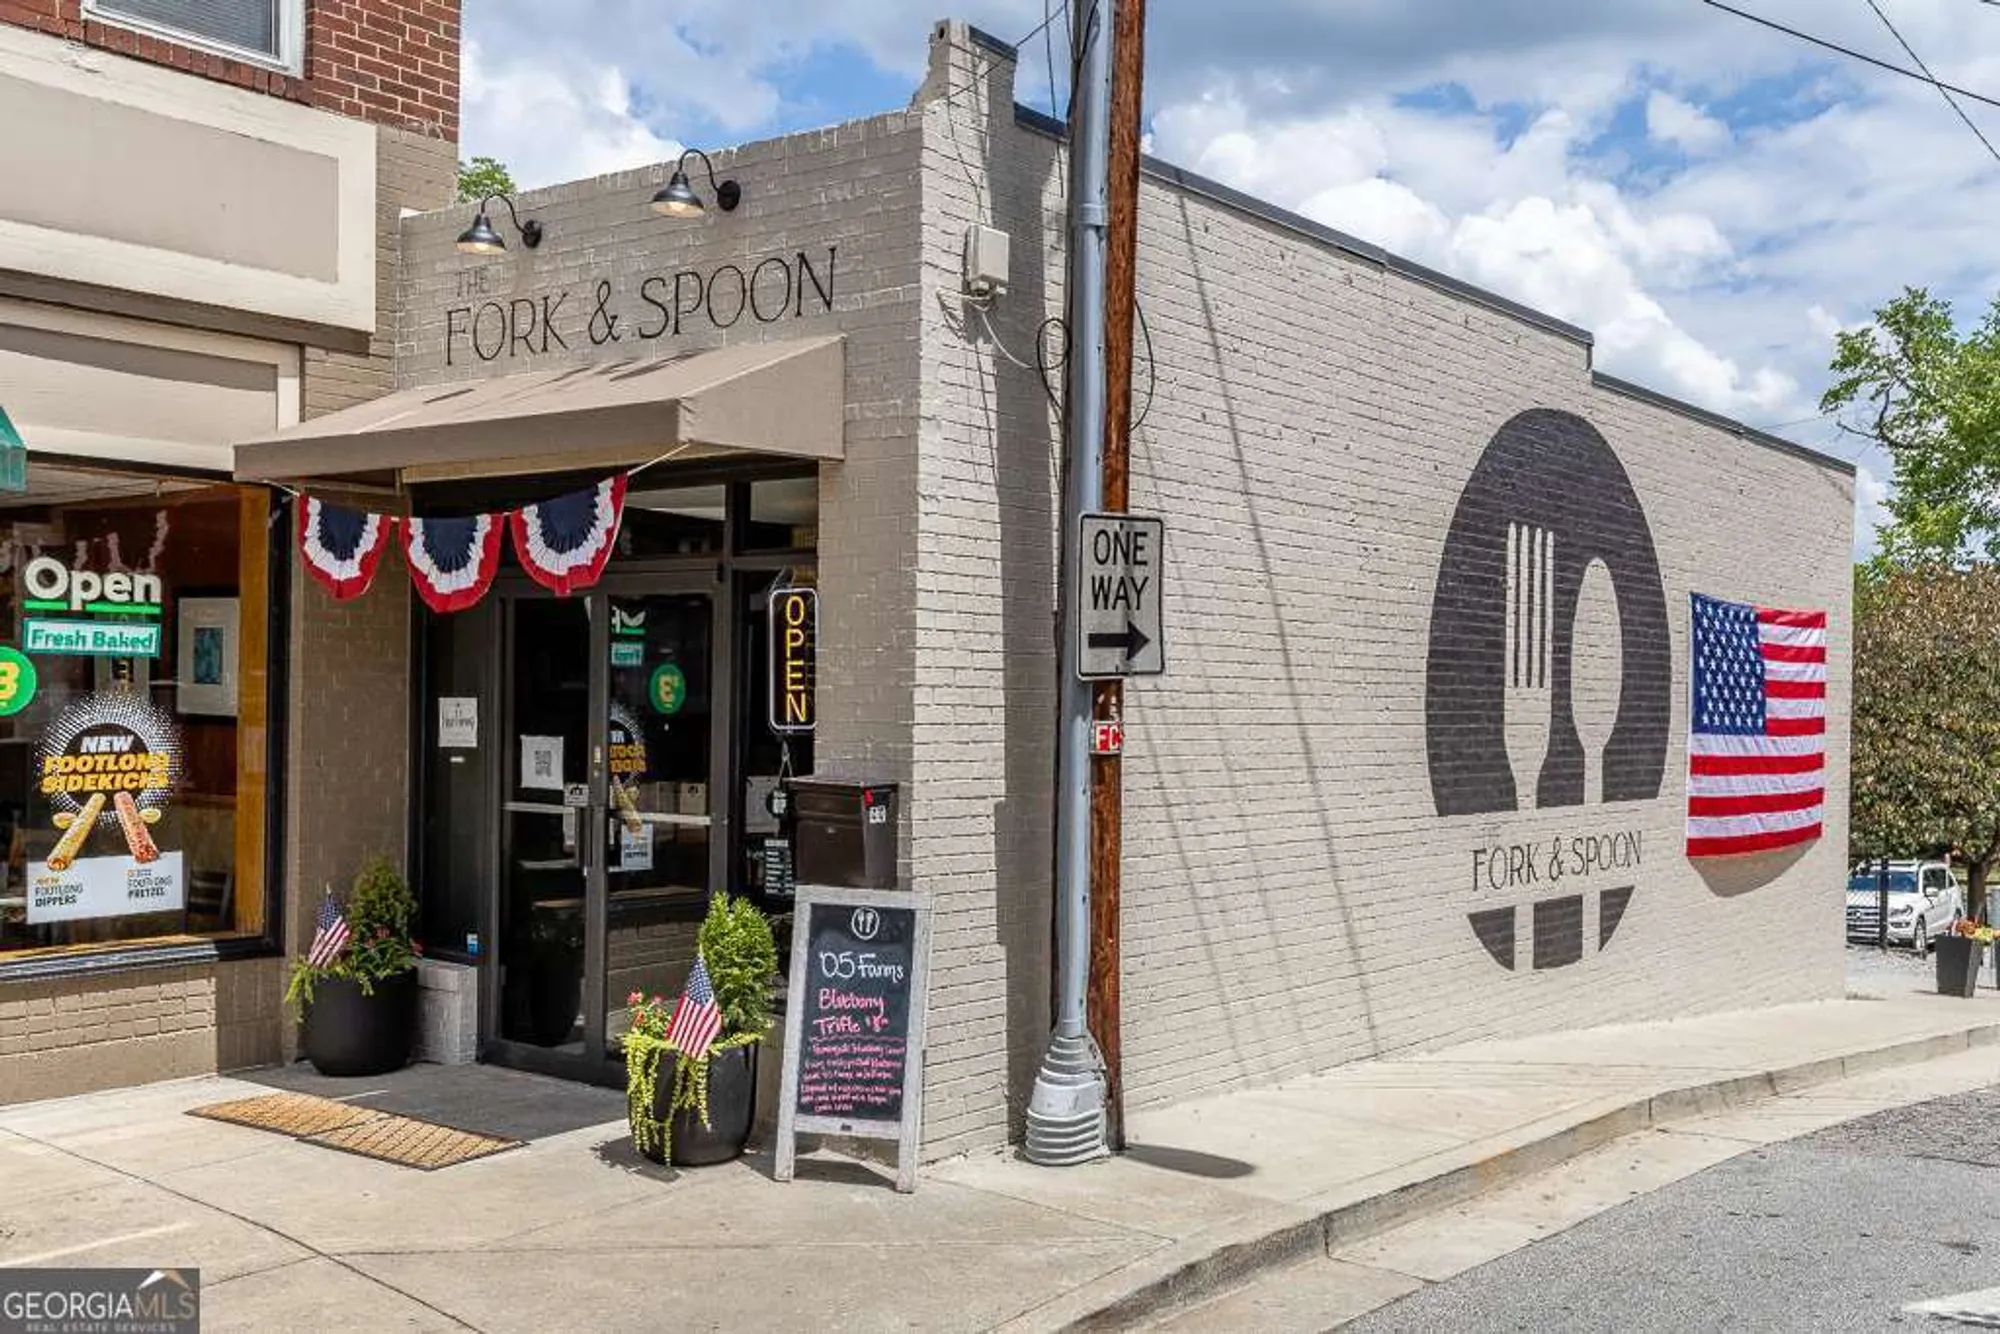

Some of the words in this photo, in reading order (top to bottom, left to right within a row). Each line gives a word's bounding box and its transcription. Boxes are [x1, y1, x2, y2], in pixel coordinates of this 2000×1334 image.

[456, 266, 490, 297] THE
[446, 292, 569, 366] FORK
[588, 280, 621, 345] &
[637, 247, 838, 340] SPOON
[1094, 529, 1148, 566] ONE
[24, 556, 162, 611] Open
[1091, 575, 1149, 611] WAY
[31, 628, 87, 648] Fresh
[92, 629, 154, 650] Baked
[785, 594, 807, 722] OPEN
[80, 735, 134, 753] NEW
[1470, 842, 1539, 892] FORK
[1549, 836, 1564, 882] &
[1571, 830, 1643, 876] SPOON
[34, 895, 78, 908] DIPPERS
[857, 953, 905, 984] Farms
[812, 1015, 861, 1036] Trifle
